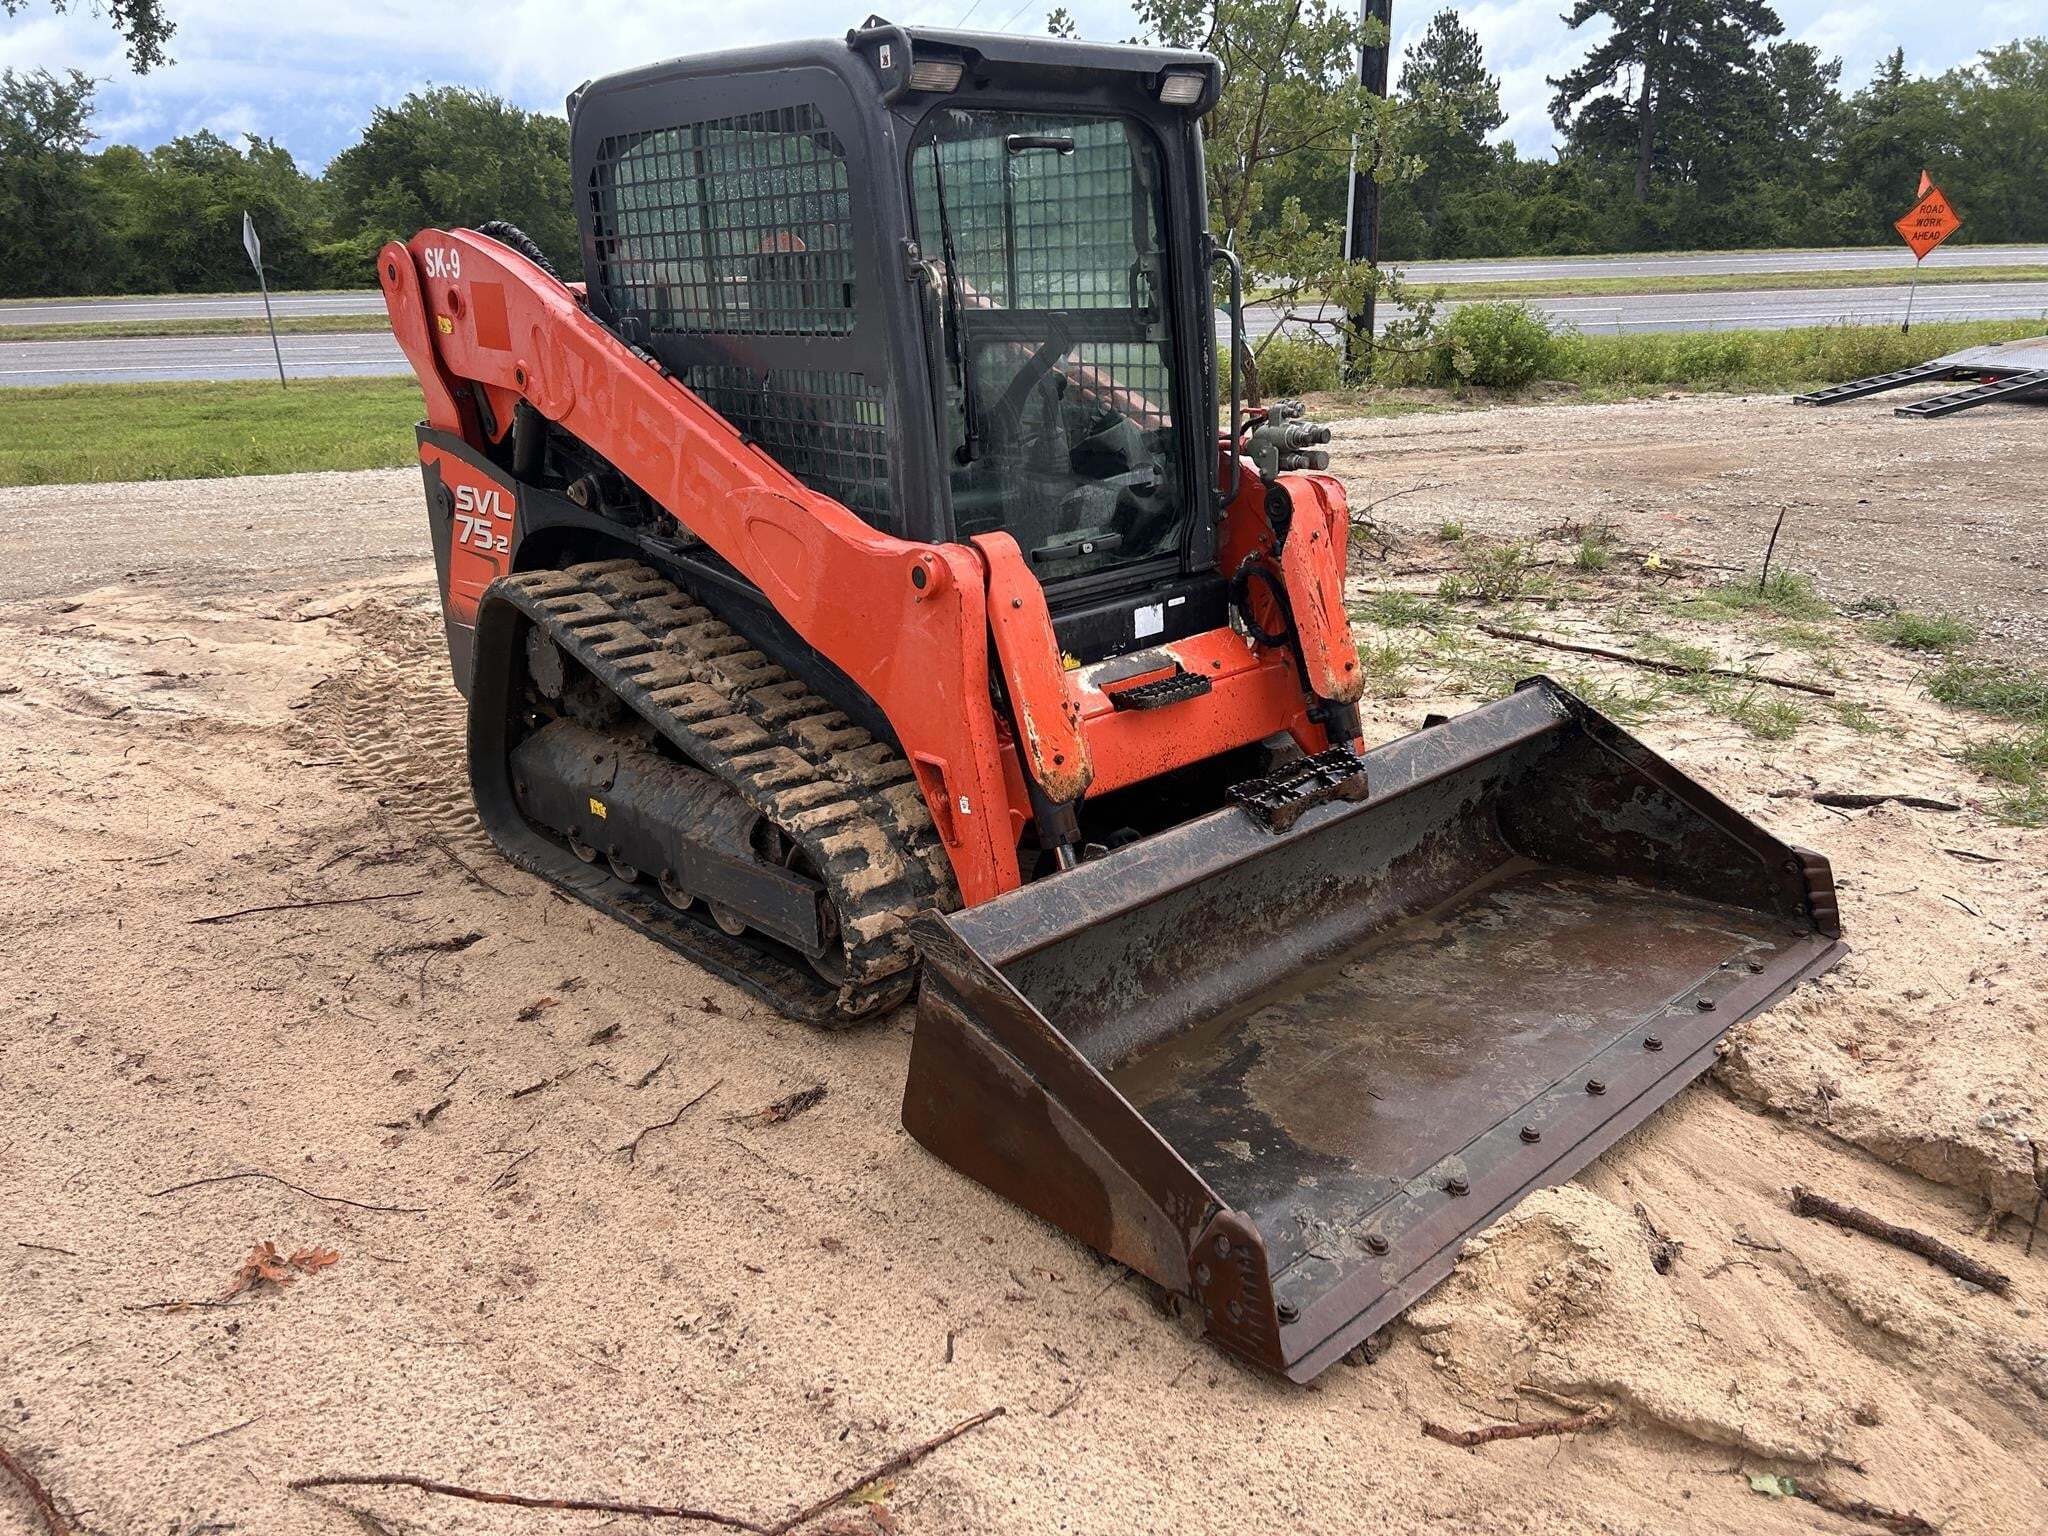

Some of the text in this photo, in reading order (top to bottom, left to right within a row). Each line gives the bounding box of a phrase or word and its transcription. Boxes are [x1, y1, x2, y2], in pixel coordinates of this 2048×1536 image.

[1919, 204, 1945, 213] ROAD
[1916, 218, 1942, 227] WORK
[1911, 231, 1941, 240] AHEAD
[424, 247, 461, 279] SK-9
[456, 484, 512, 521] SVL
[455, 514, 510, 554] 75-2
